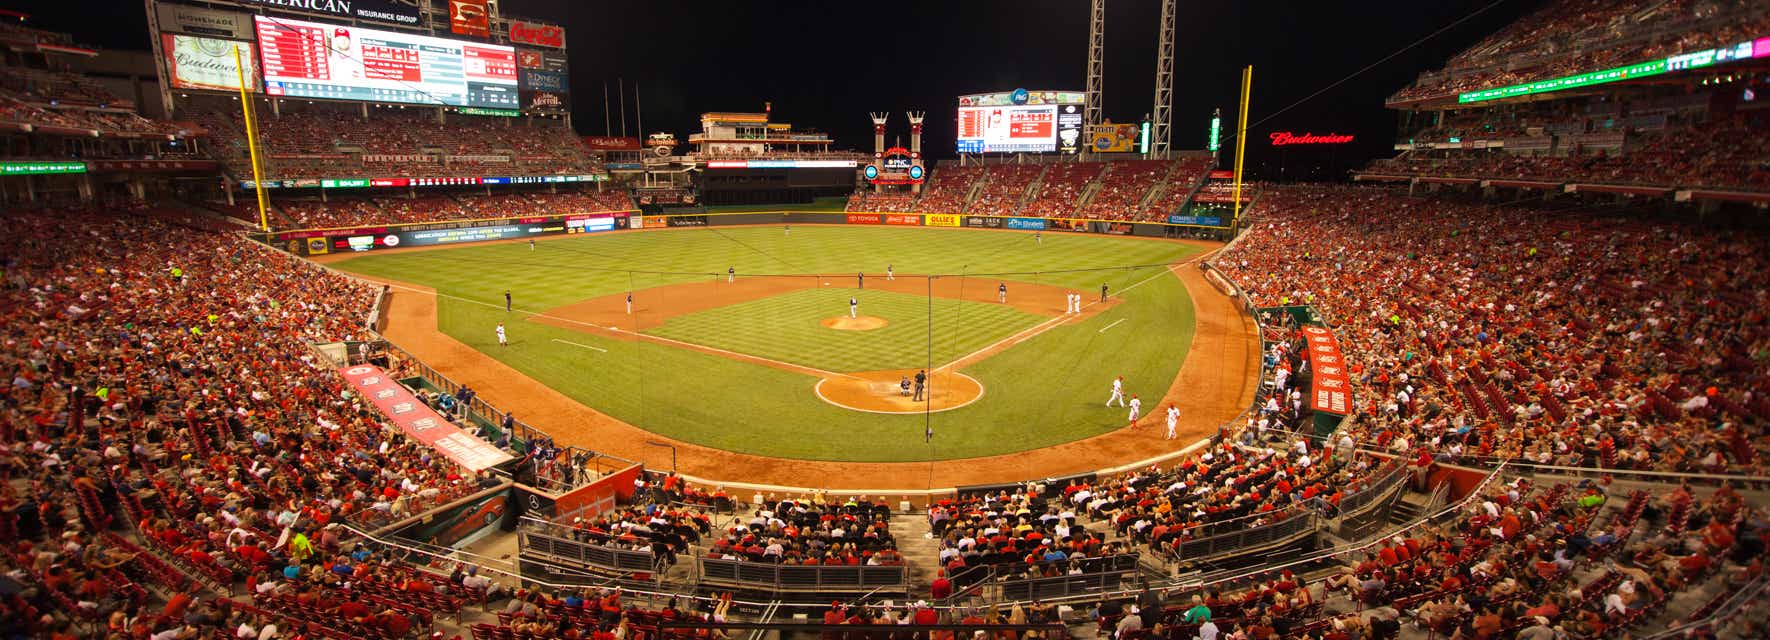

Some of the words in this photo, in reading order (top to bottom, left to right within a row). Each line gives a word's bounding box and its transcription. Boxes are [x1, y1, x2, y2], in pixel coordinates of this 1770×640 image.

[177, 12, 233, 26] HOMEMADE
[357, 9, 396, 21] INSURANCE
[396, 14, 418, 23] GROUP
[175, 52, 252, 73] Budwei
[1270, 132, 1354, 146] Budweiser
